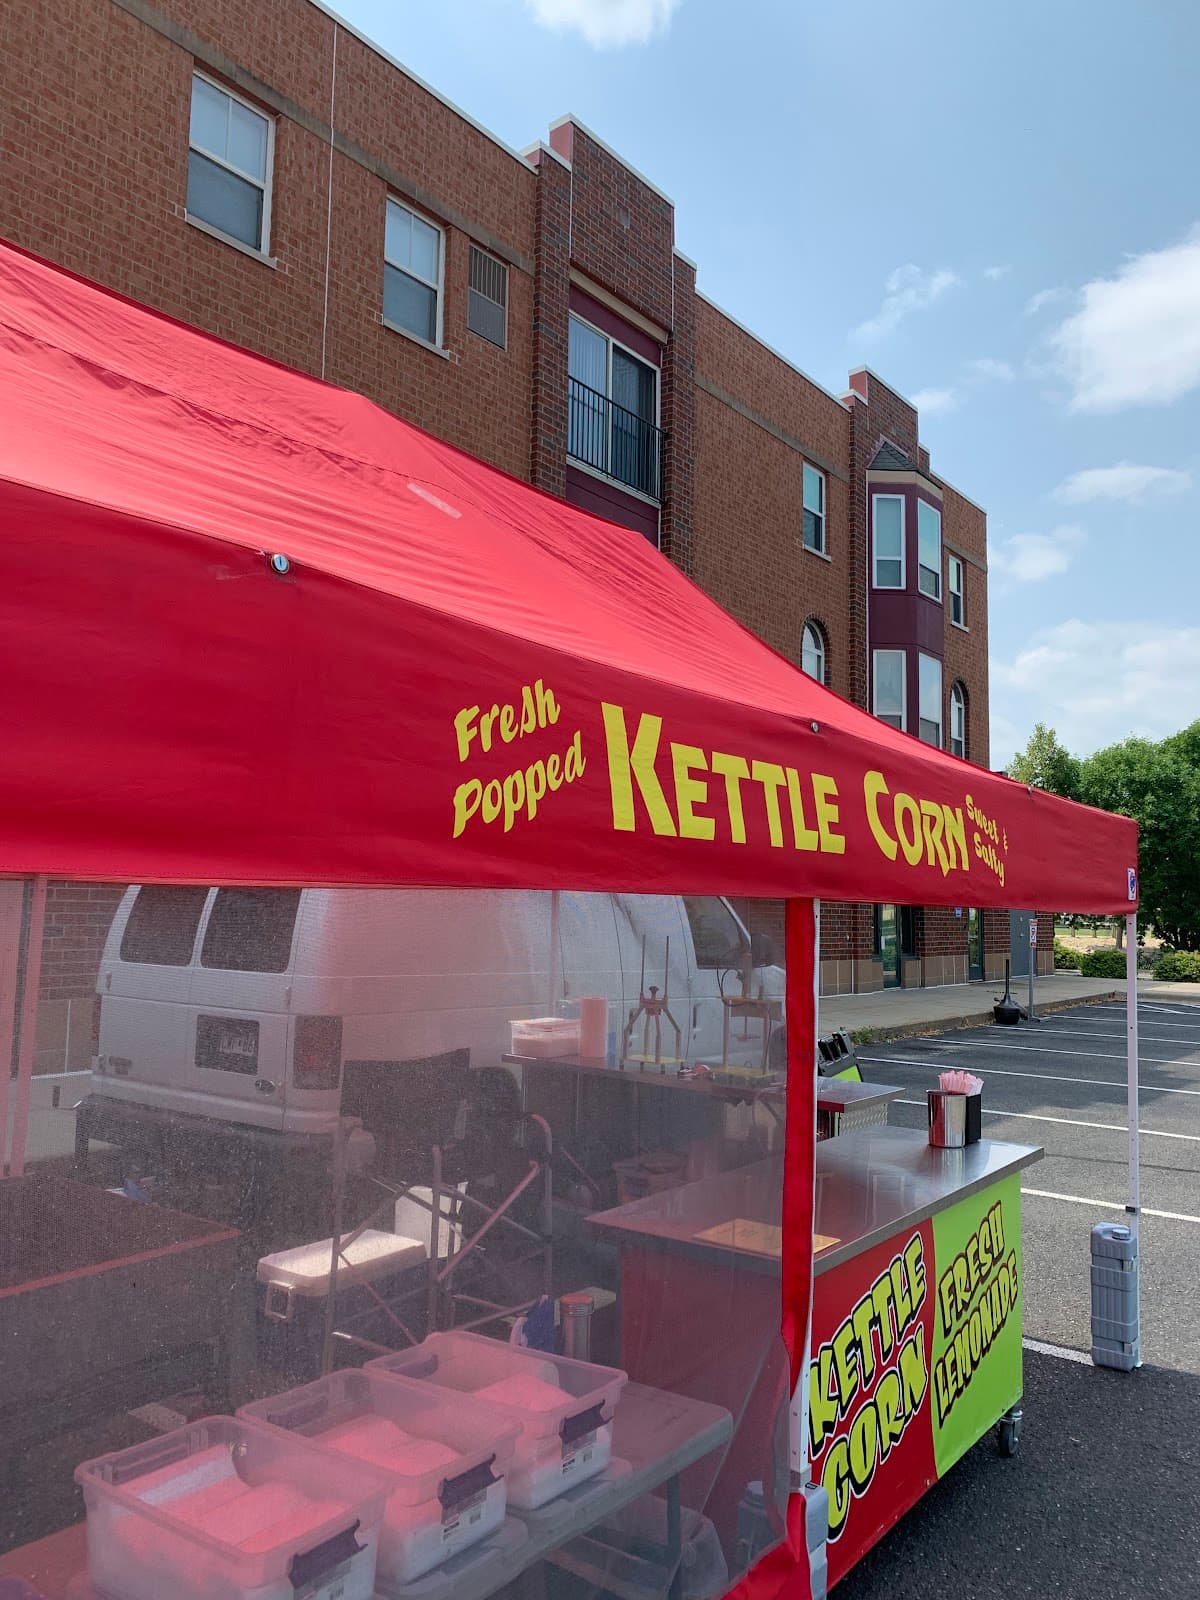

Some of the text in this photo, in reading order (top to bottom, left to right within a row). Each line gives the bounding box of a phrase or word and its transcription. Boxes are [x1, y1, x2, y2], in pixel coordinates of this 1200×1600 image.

[452, 730, 587, 839] Popped
[453, 678, 561, 763] Fresh
[601, 701, 970, 878] KETTLE CORN
[965, 794, 999, 845] Sweet
[973, 832, 1005, 887] Salty
[939, 1200, 1005, 1338] FRESH
[808, 1231, 927, 1461] KETTLE
[934, 1249, 1018, 1428] LEMONADE
[821, 1321, 928, 1544] CORN
